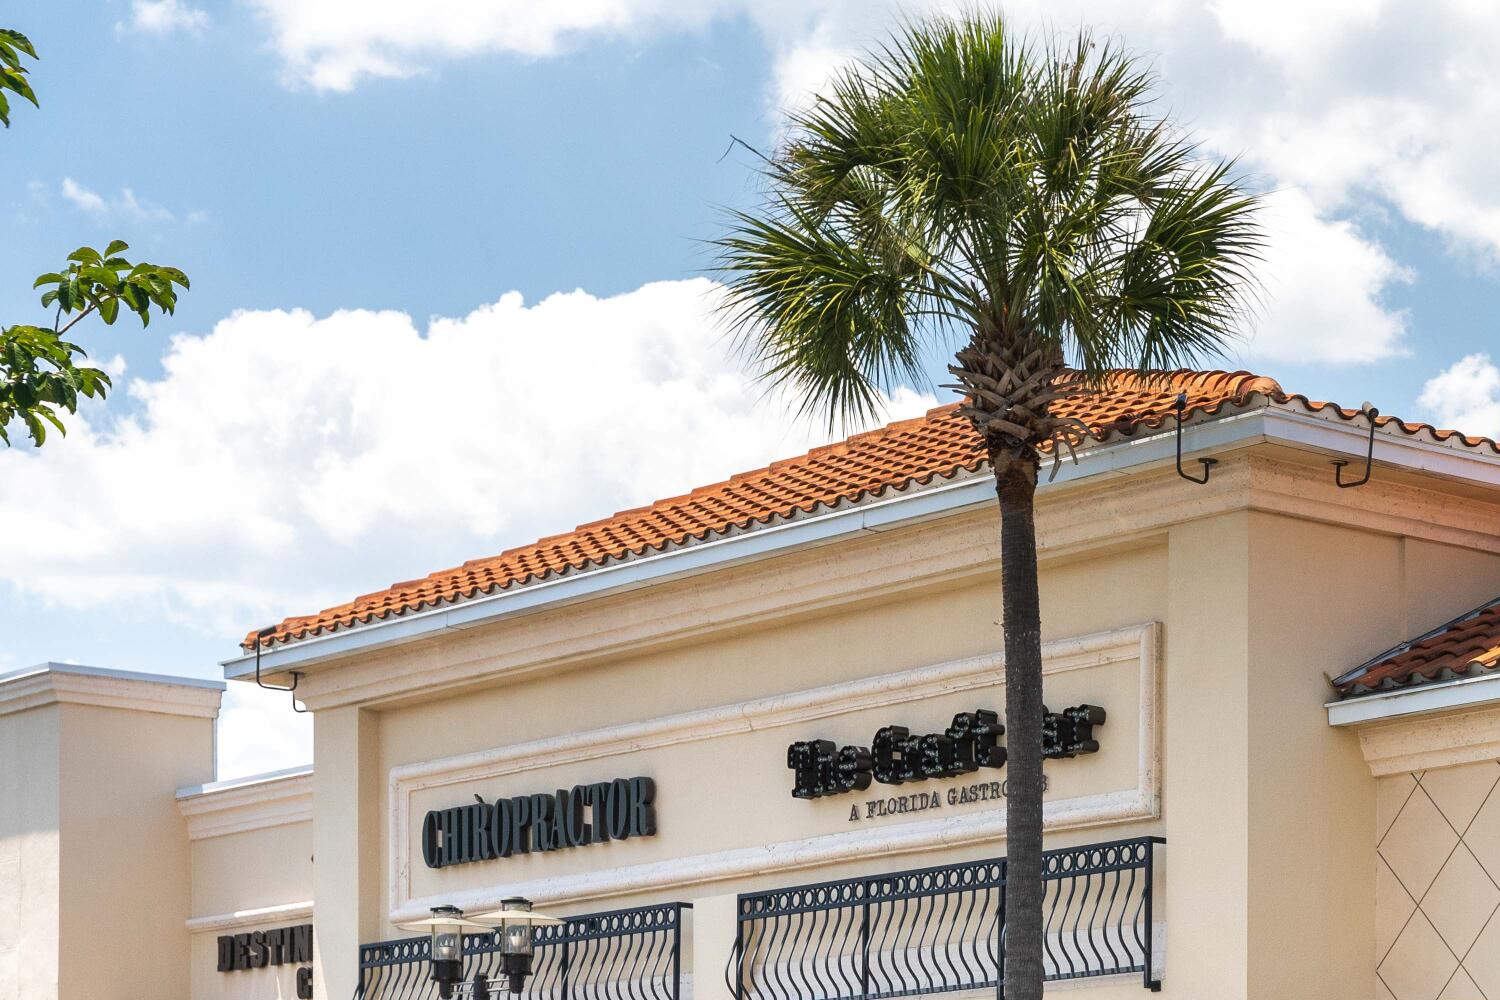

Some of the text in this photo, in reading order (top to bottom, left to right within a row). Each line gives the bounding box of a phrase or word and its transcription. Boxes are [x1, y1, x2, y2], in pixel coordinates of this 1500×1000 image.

[787, 739, 872, 800] The
[871, 709, 1007, 785] Craft
[422, 776, 657, 869] CHIROPRACTOR
[848, 803, 860, 822] A
[865, 789, 941, 819] FLORIDA
